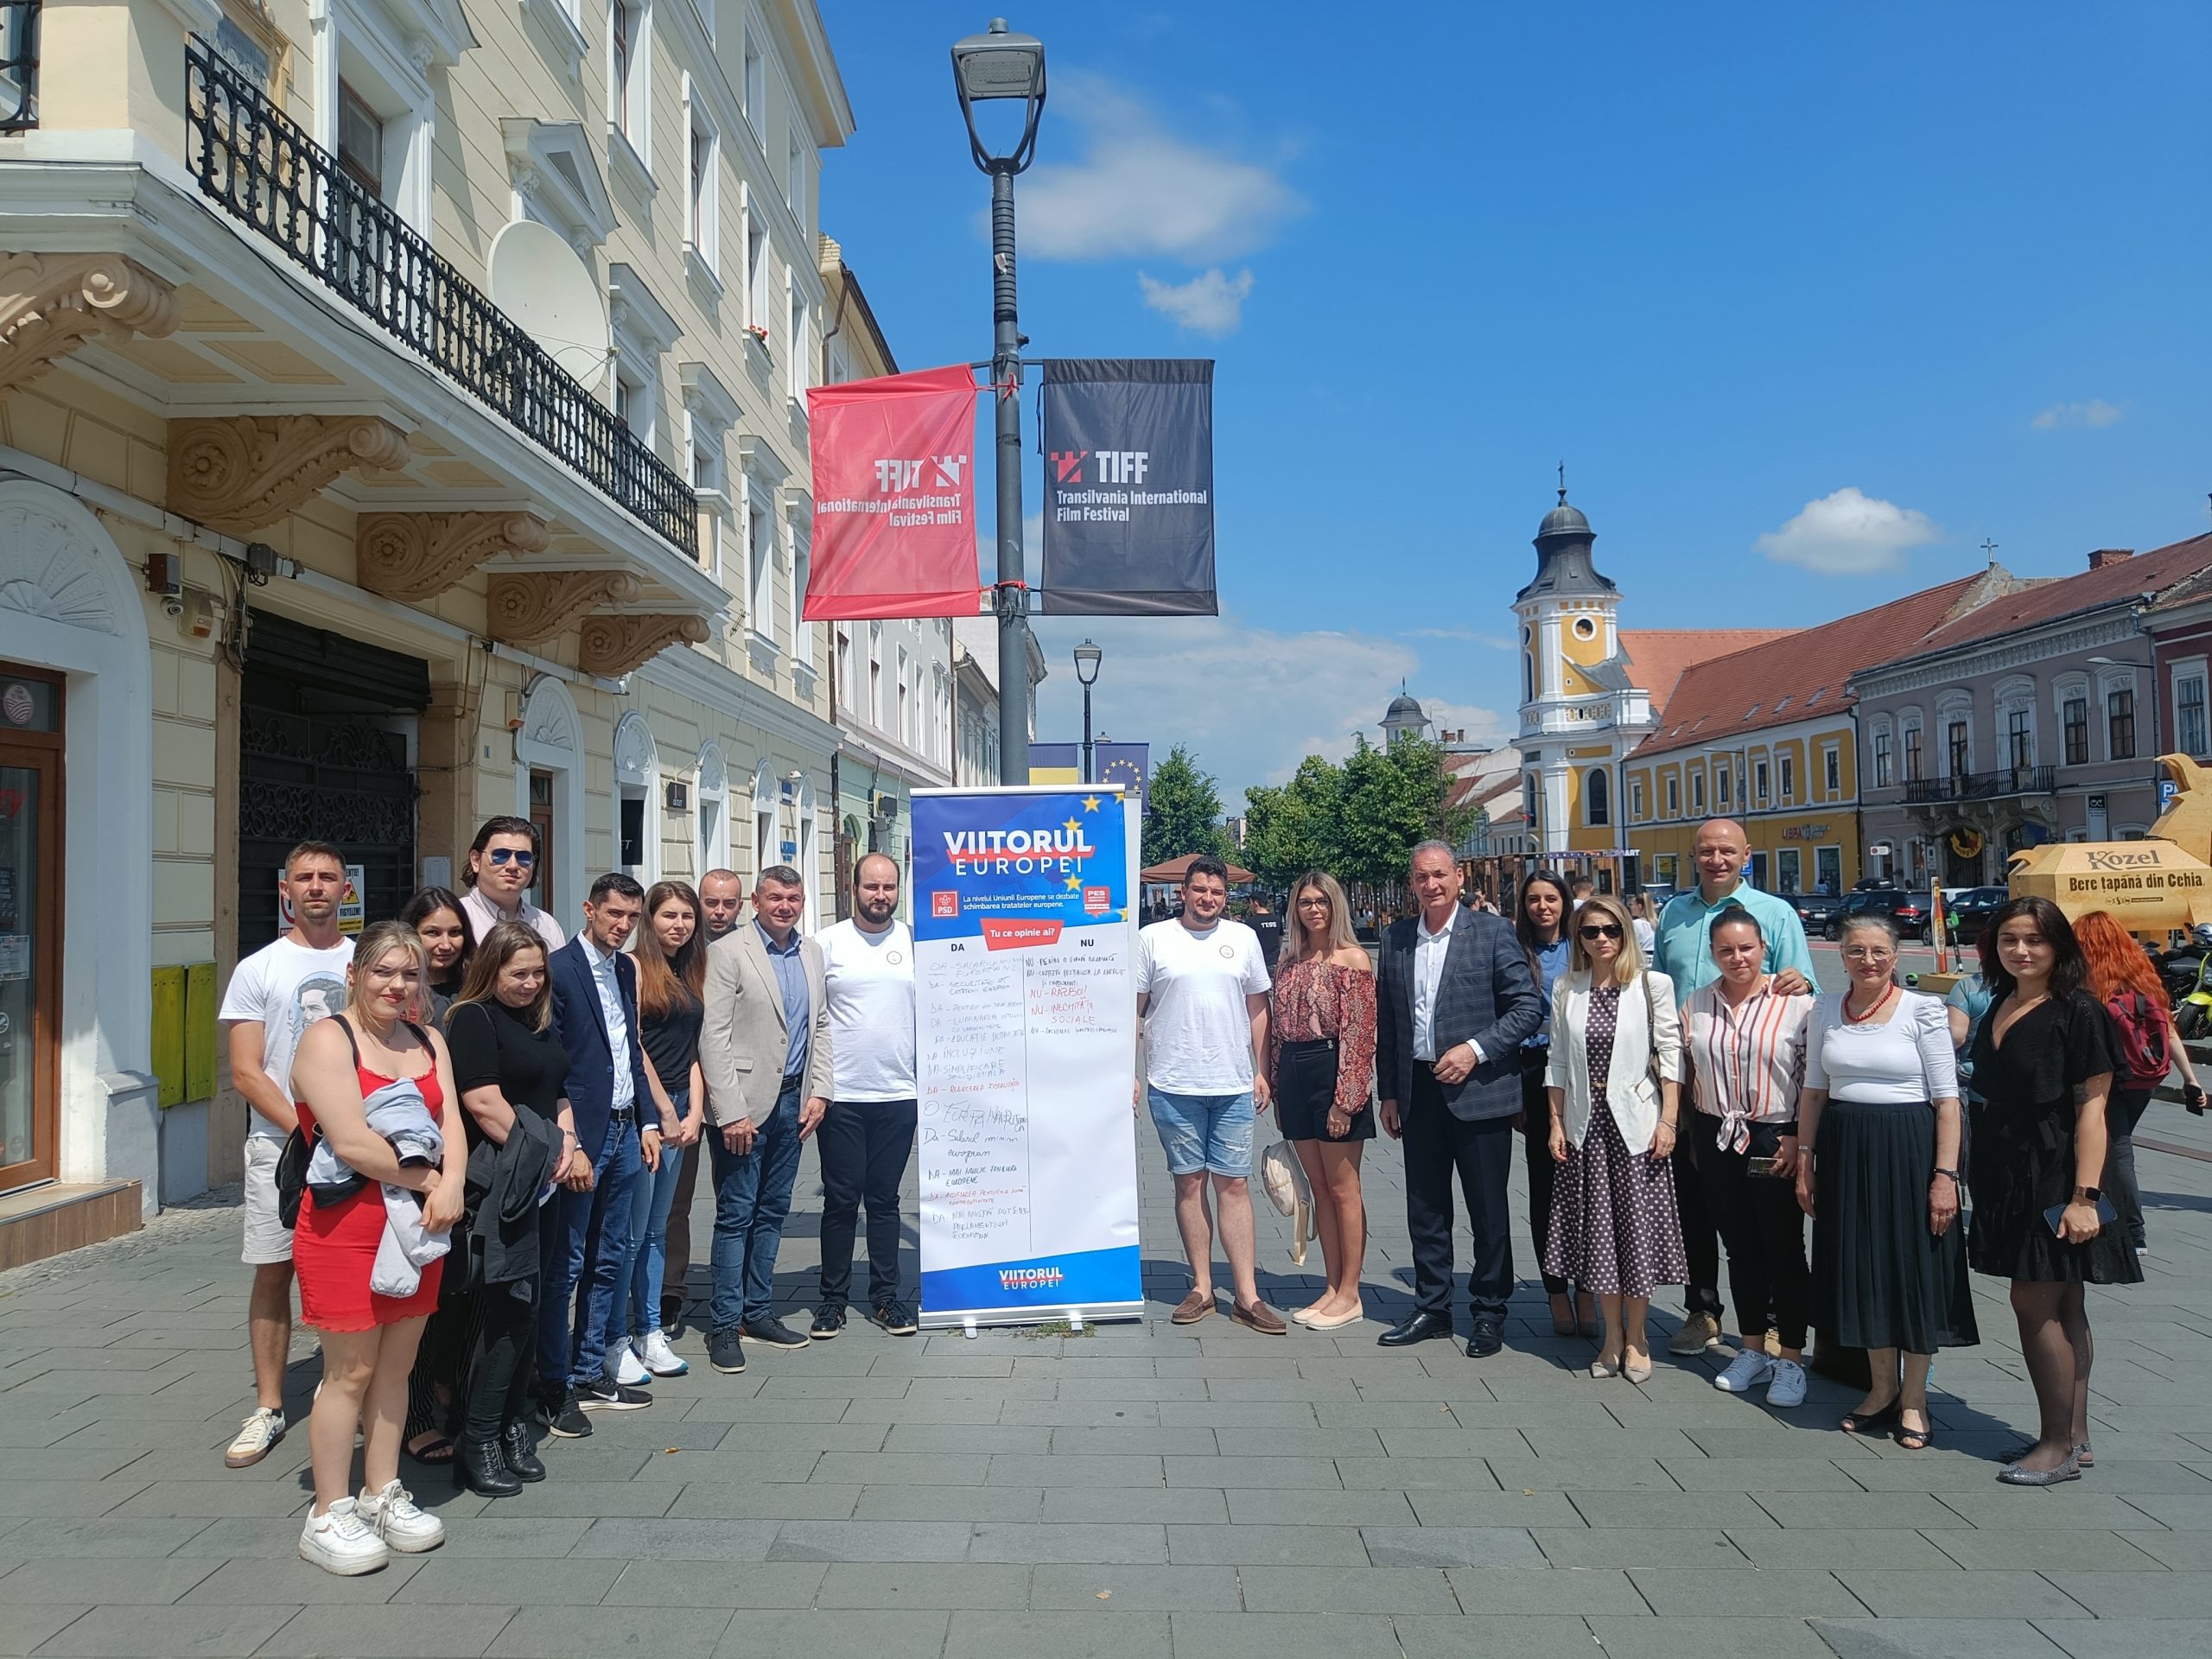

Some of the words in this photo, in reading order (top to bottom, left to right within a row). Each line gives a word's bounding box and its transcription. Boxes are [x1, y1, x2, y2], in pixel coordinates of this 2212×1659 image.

[1096, 451, 1148, 484] TIFF
[1057, 489, 1128, 505] Transilvania
[1130, 489, 1207, 505] International
[1057, 507, 1081, 522] Film
[1084, 507, 1129, 522] Festival
[943, 830, 1093, 855] VIITORUL
[956, 855, 1082, 876] EUROPEI
[2085, 849, 2162, 871] Kozel
[2069, 877, 2097, 892] Bere
[2146, 874, 2164, 888] din
[1014, 929, 1040, 938] opinie
[1030, 988, 1042, 999] NU
[1031, 1004, 1043, 1015] NU
[999, 1267, 1063, 1281] VIITORUL
[1004, 1279, 1059, 1290] EUROPEI
